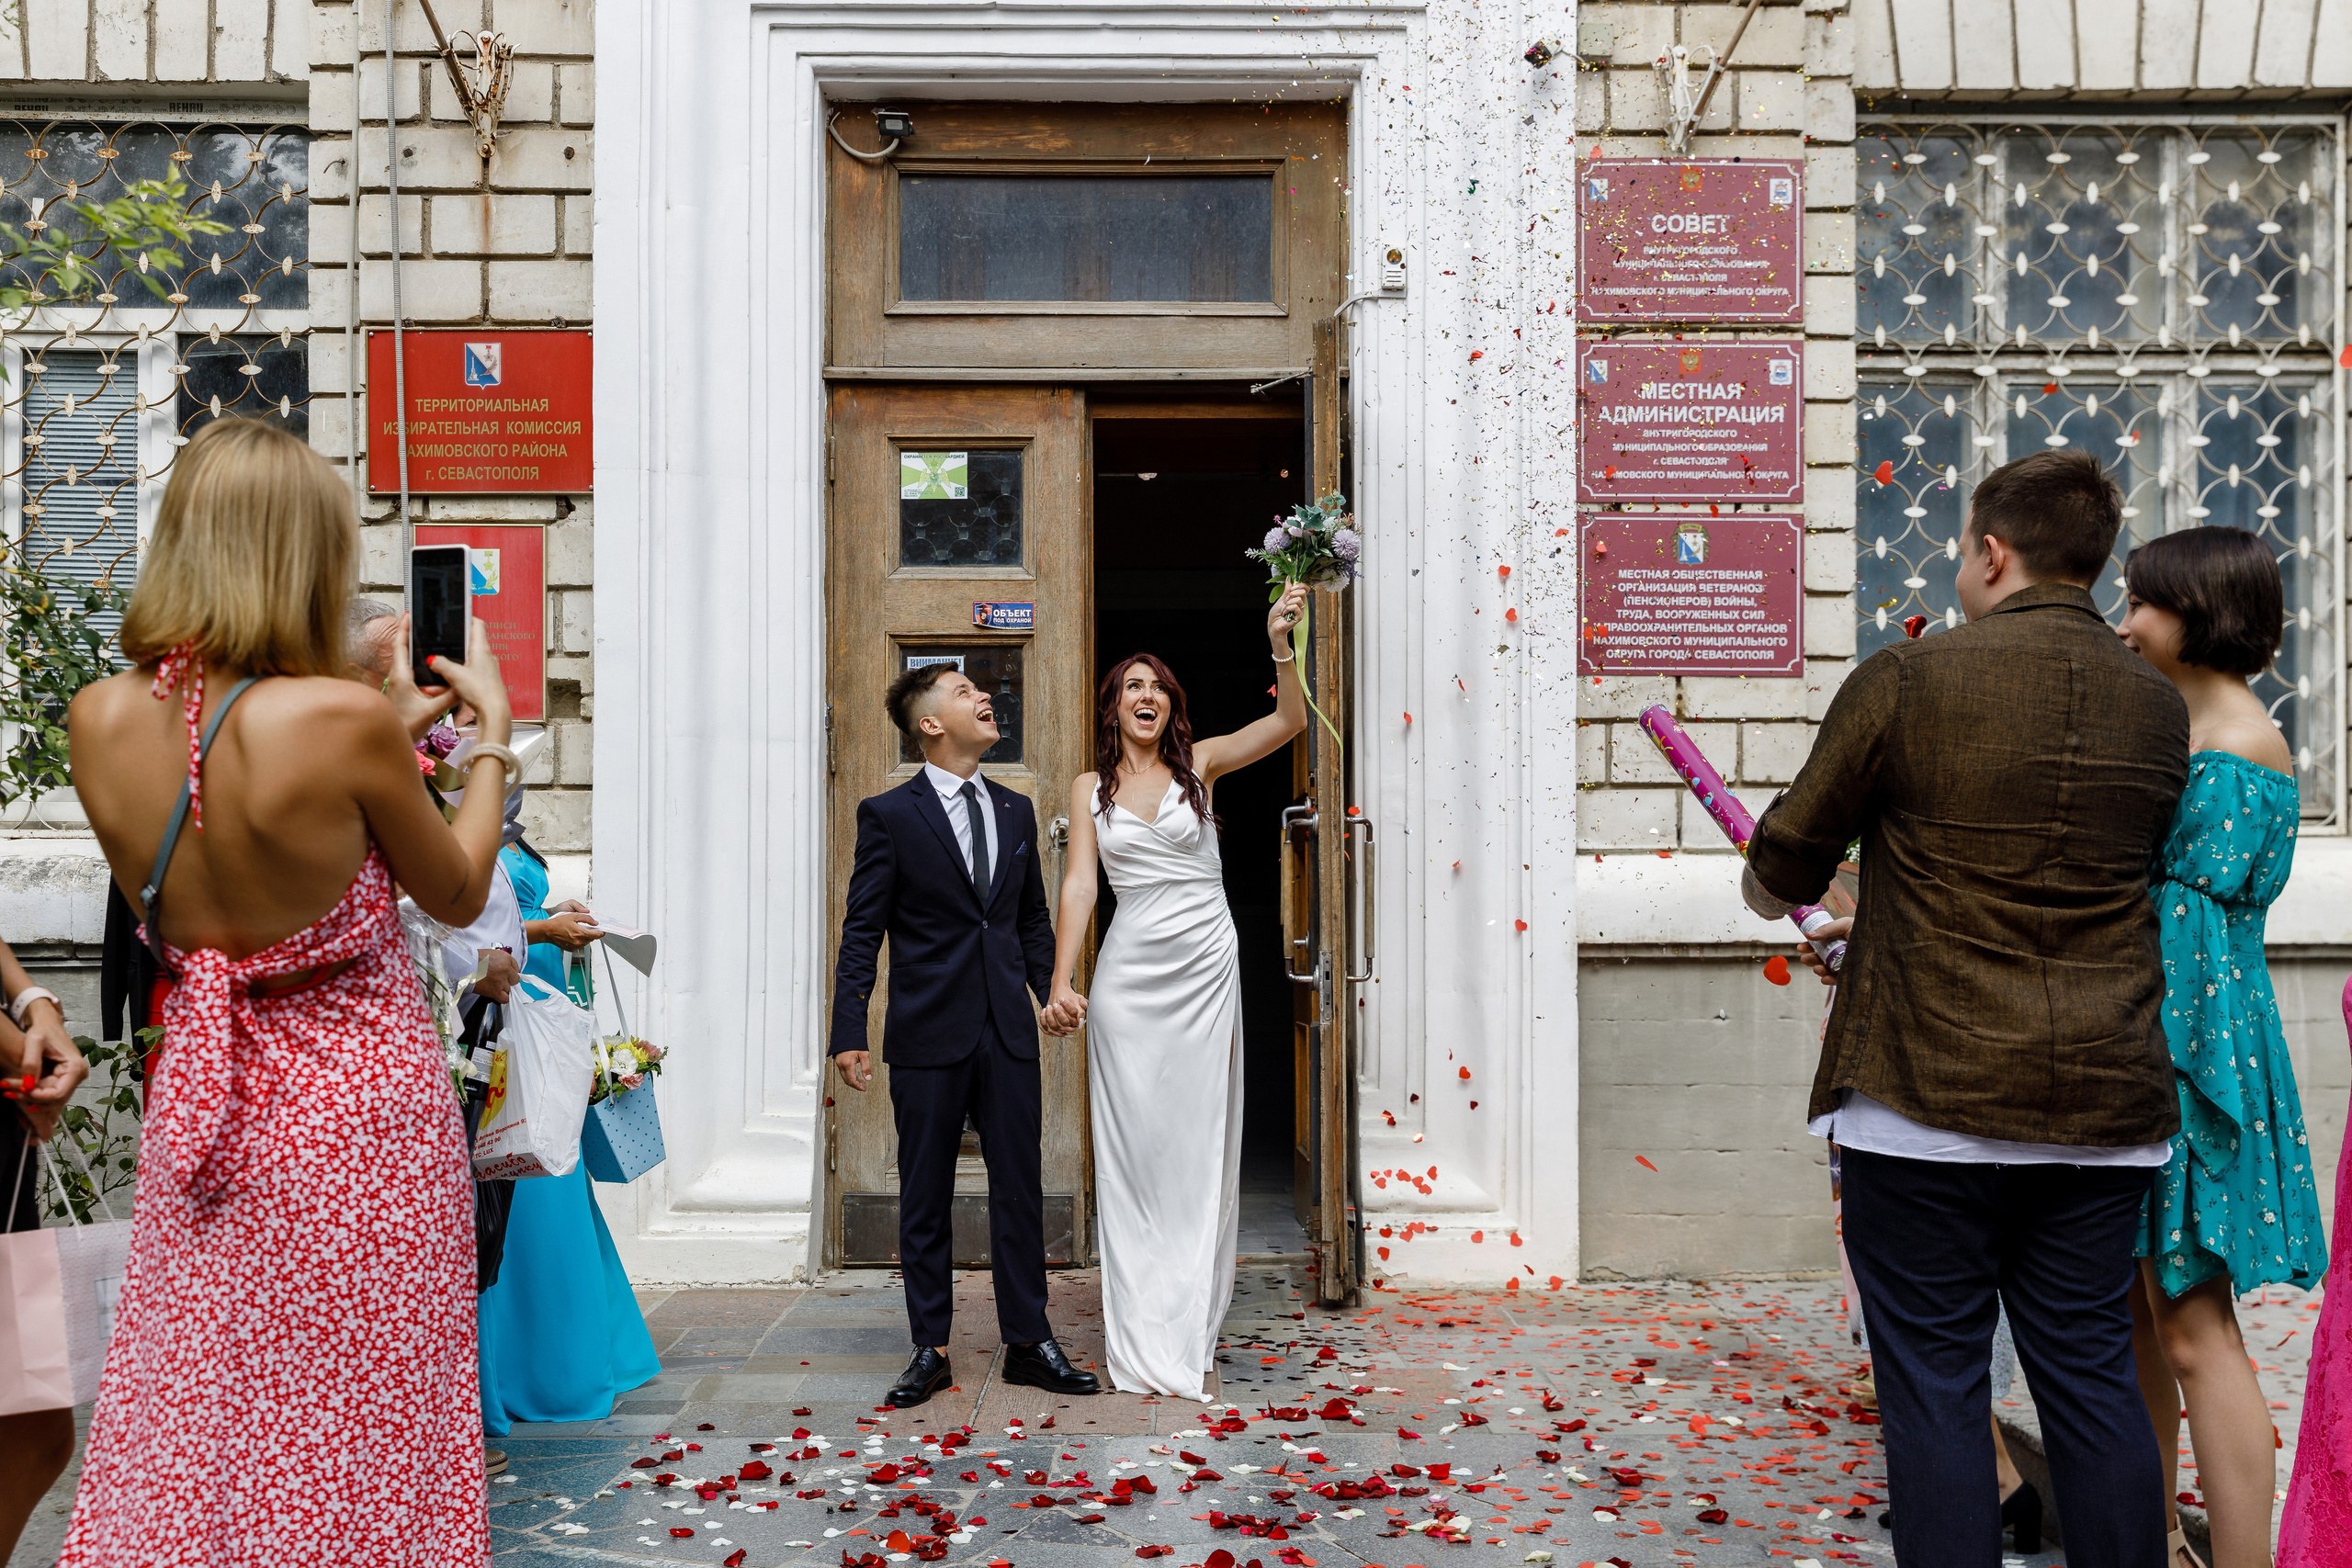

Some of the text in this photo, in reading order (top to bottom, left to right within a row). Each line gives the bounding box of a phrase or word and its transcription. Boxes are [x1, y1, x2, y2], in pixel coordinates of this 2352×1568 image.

[1651, 214, 1730, 232] СОВЕТ
[1755, 288, 1789, 296] ОКРУГА
[1640, 383, 1741, 400] МЕСТНАЯ
[415, 399, 548, 412] ТЕРРИТОРИАЛЬНАЯ
[1598, 405, 1784, 425] АДМИНИСТРАЦИЯ
[506, 421, 581, 434] КОМИССИЯ
[1643, 429, 1737, 438] ВНУТРИГОРОДСКОГО
[398, 440, 568, 457] АХИМОВСКОГО РАЙОНА
[1612, 443, 1699, 452] МУНИЦИПАЛЬНОГО
[1660, 457, 1727, 466] СЕВАСТОПОЛЯ
[425, 466, 539, 480] г. СЕВАСТОПОЛЯ
[1755, 471, 1789, 479] ОКРУГА
[1618, 570, 1763, 581] МЕСТНАЯ ОБЩЕСТВЕННАЯ
[1617, 583, 1763, 593] ОРГАНИЗАЦИЯ ВЕТЕРАНОВ
[1623, 595, 1758, 607] (ПЕНСИОНЕРОВ) ВОЙНЫ,
[993, 609, 1031, 617] ОБЪЕКТ
[1616, 610, 1765, 620] ТРУДА, ВООРУЖЕННЫХ СИЛ
[1603, 623, 1734, 633] ПРАВООХРАНИТЕЛЬНЫХ
[1736, 623, 1788, 633] ОРГАНОВ
[1593, 637, 1788, 648] НАХИМОВСКОГО МУНИЦИПАЛЬНОГО
[1606, 649, 1774, 660] ОКРУГА ГОРОДА СЕВАСТОПОЛЯ
